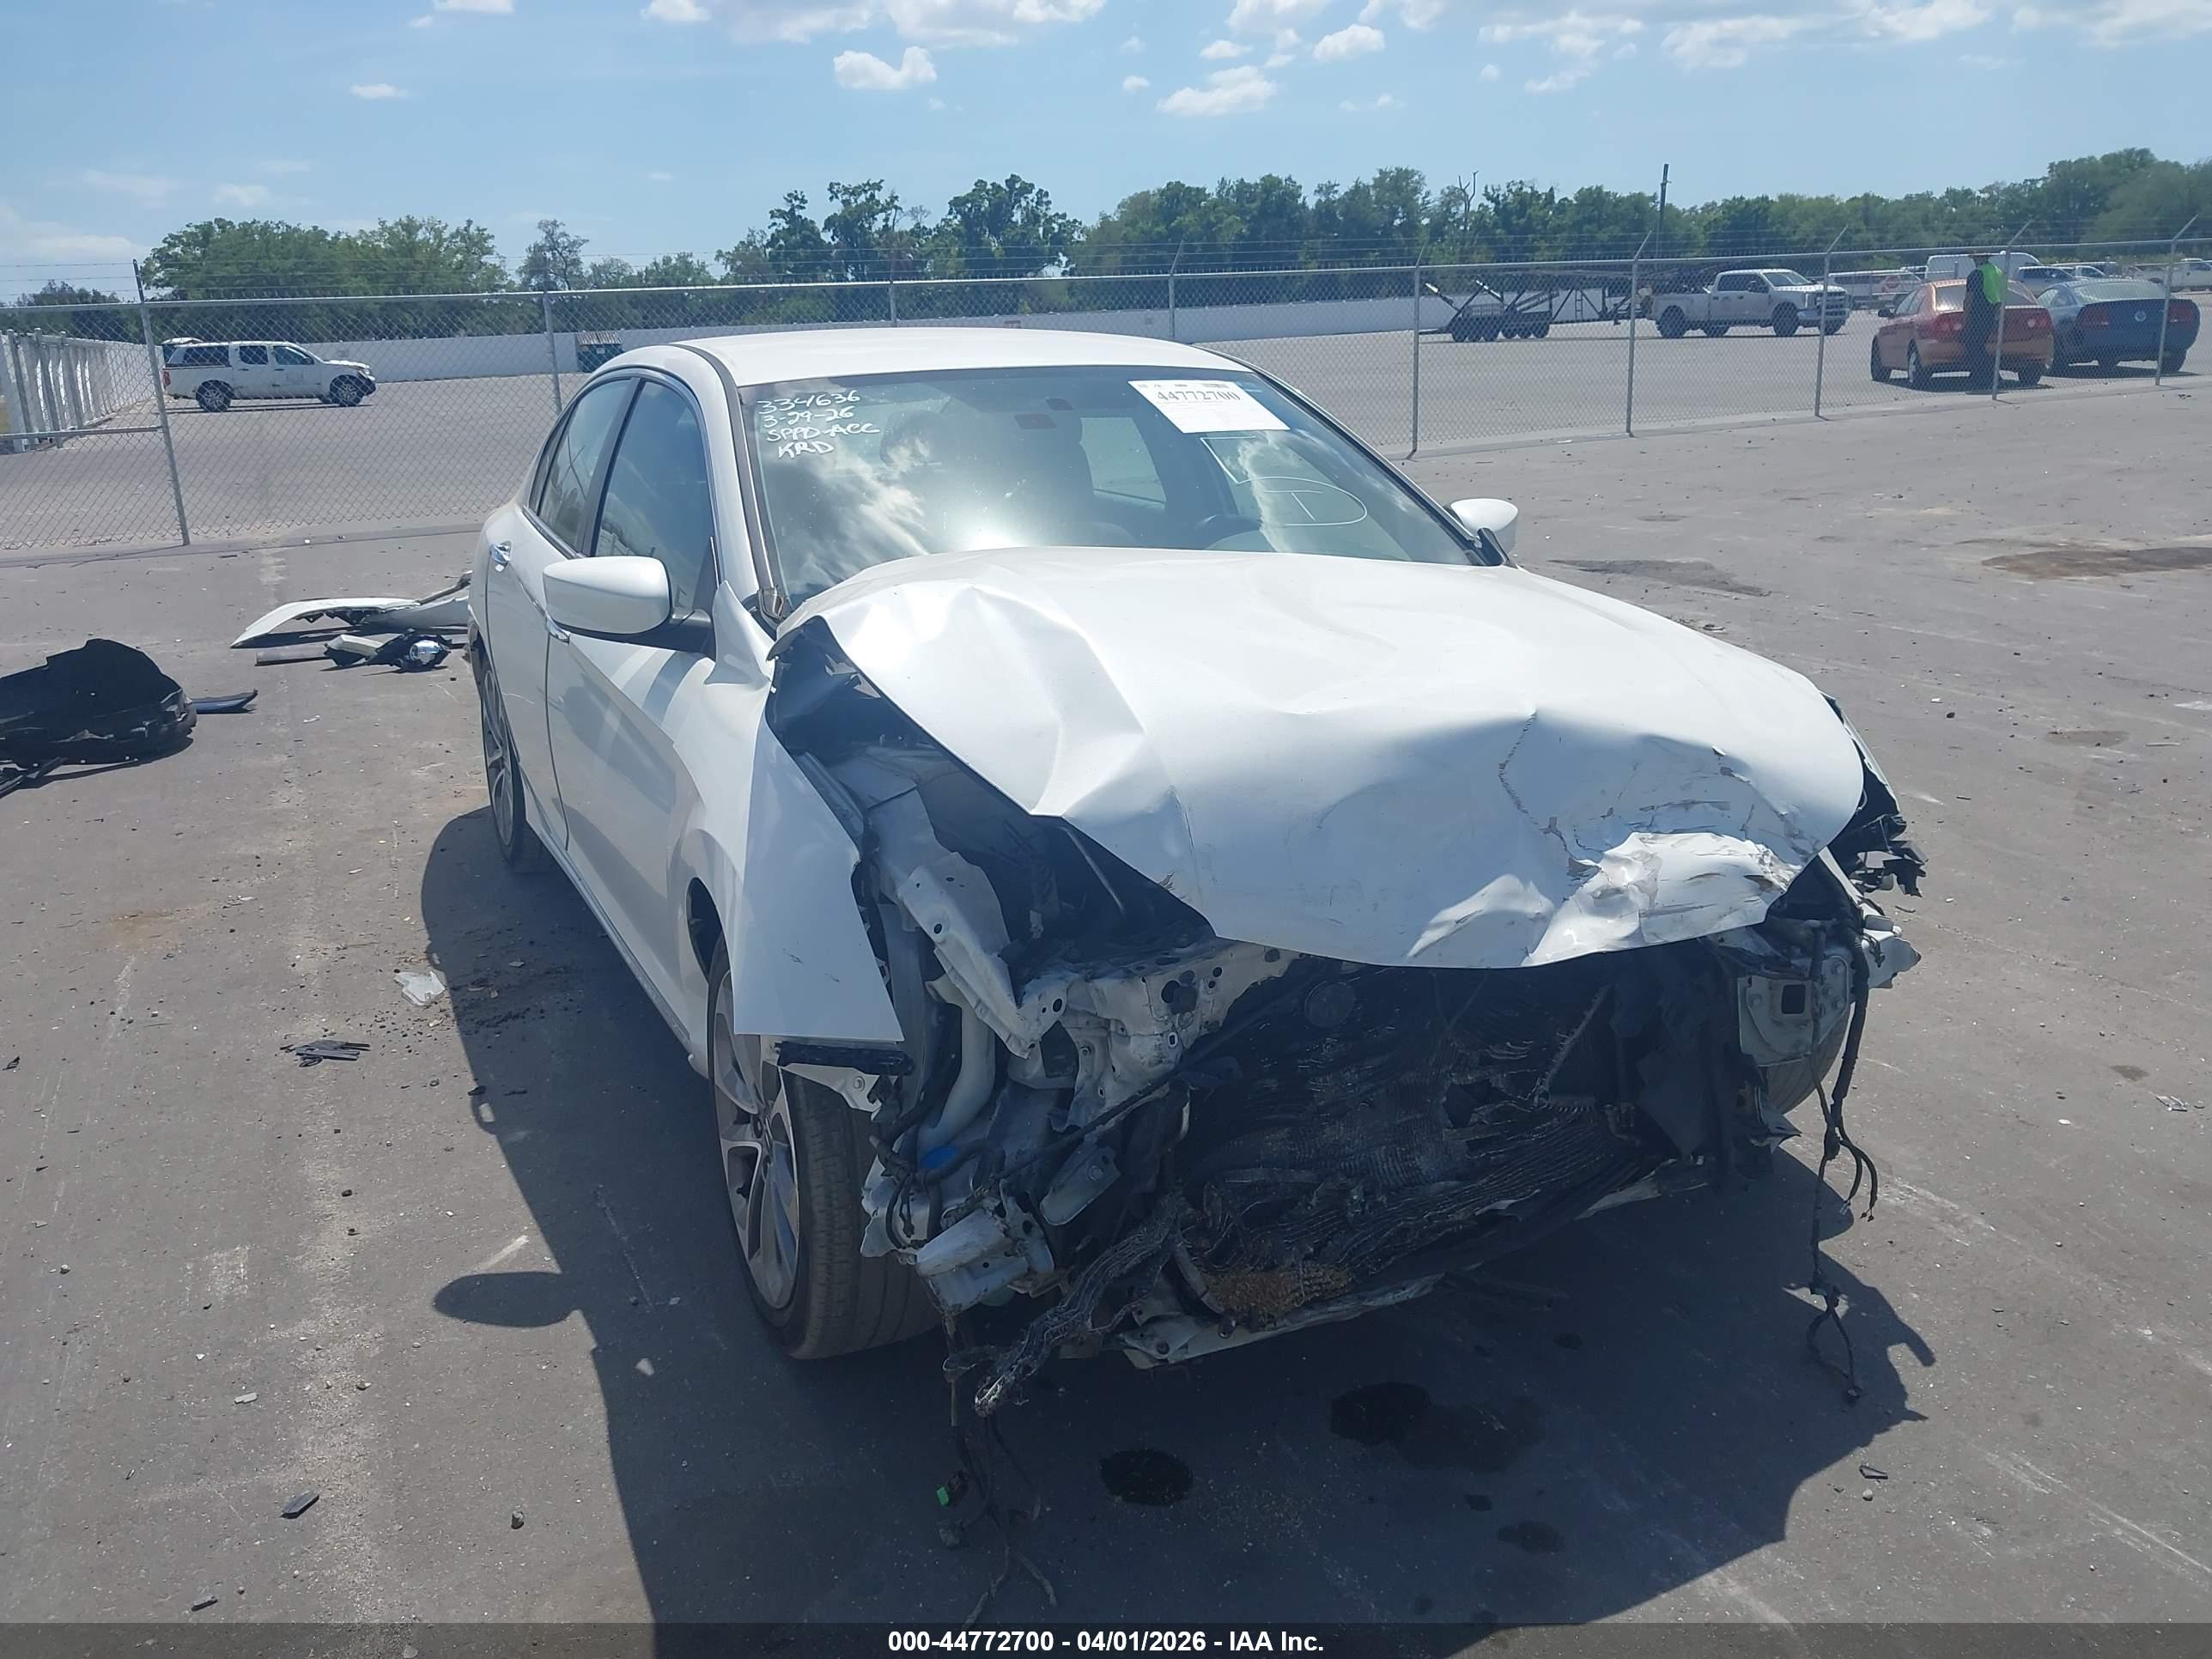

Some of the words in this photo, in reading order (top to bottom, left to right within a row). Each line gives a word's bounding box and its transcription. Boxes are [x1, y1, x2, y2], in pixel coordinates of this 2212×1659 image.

[1157, 391, 1242, 401] 44772700
[763, 406, 854, 428] 3-29-26
[778, 441, 834, 459] KRD
